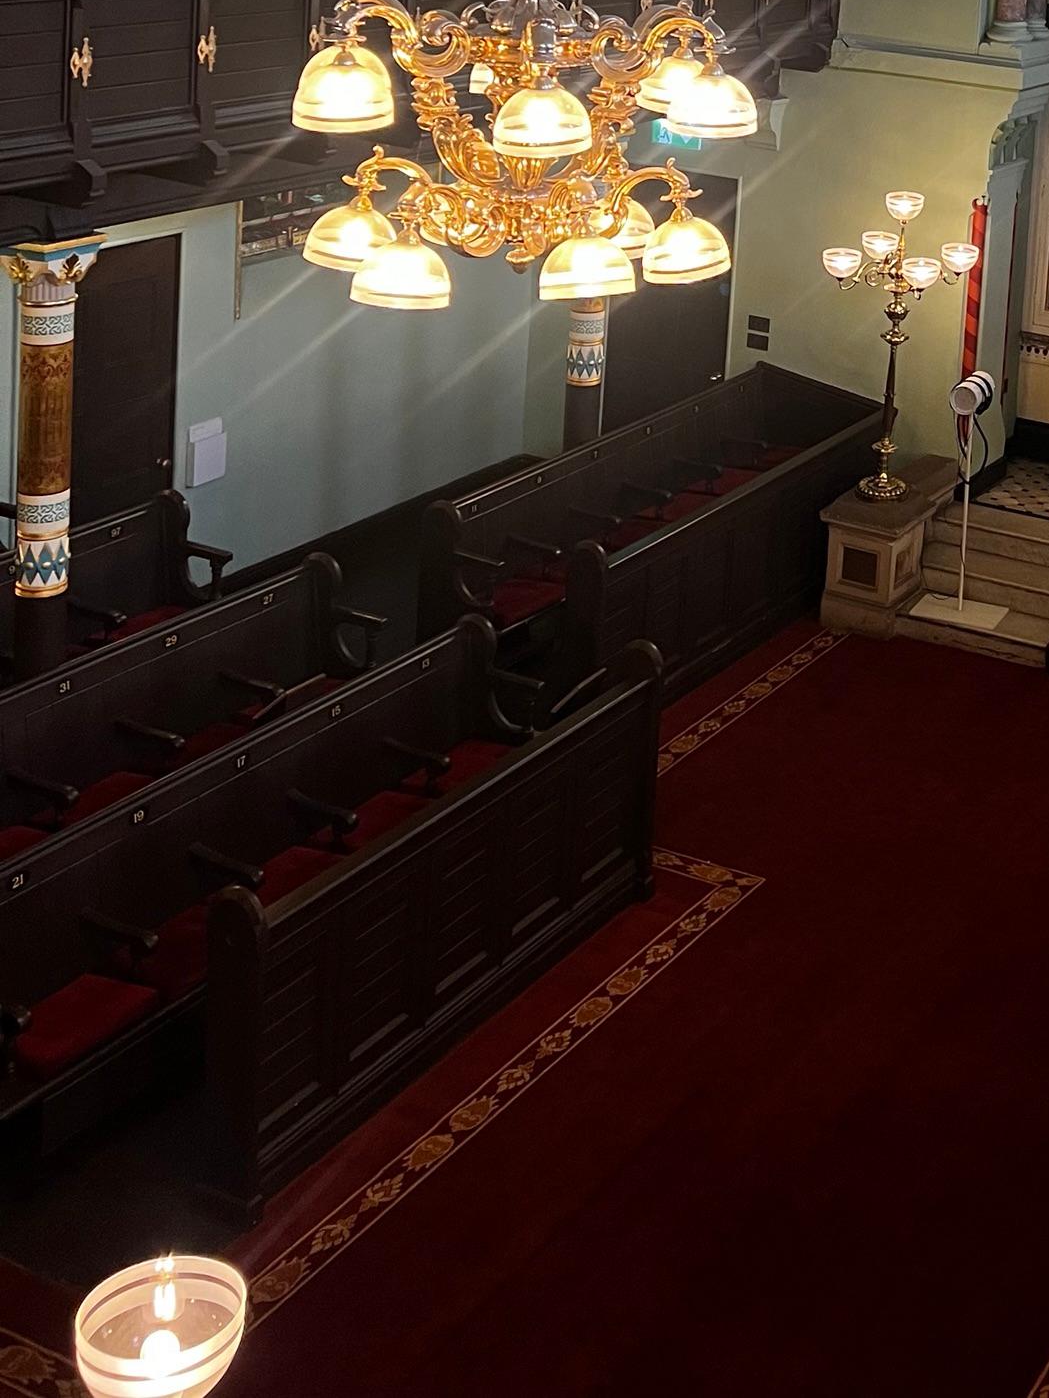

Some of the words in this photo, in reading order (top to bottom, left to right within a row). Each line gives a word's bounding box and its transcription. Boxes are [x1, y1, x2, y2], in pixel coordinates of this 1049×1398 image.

[110, 526, 122, 538] 97
[263, 593, 274, 605] 27
[165, 634, 178, 648] 29
[59, 680, 71, 694] 31
[331, 705, 342, 718] 15
[237, 755, 247, 769] 17
[133, 809, 145, 824] 19
[11, 873, 24, 890] 21
